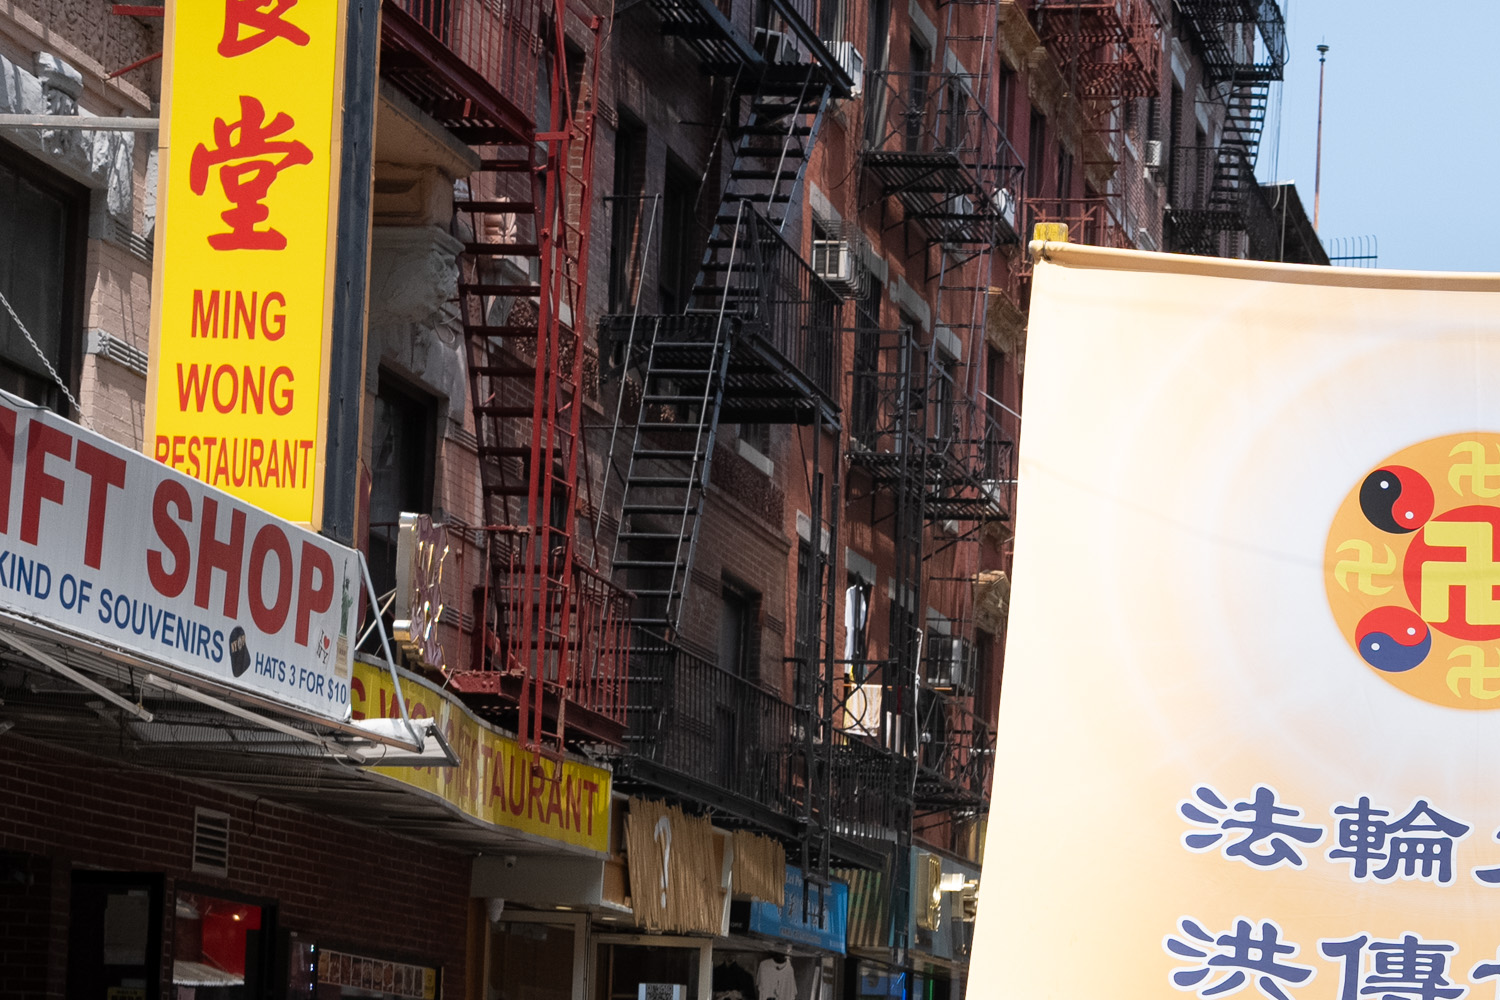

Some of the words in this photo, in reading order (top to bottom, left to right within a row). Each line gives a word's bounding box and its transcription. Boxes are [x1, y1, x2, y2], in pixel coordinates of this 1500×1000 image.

[190, 288, 286, 342] MING
[176, 363, 294, 416] WONG
[146, 478, 335, 648] SHOP
[59, 573, 93, 614] OF
[98, 588, 225, 664] SOUVENIRS
[254, 651, 286, 683] HATS
[288, 666, 296, 689] 3
[299, 668, 324, 698] FOR
[327, 681, 347, 706] $10
